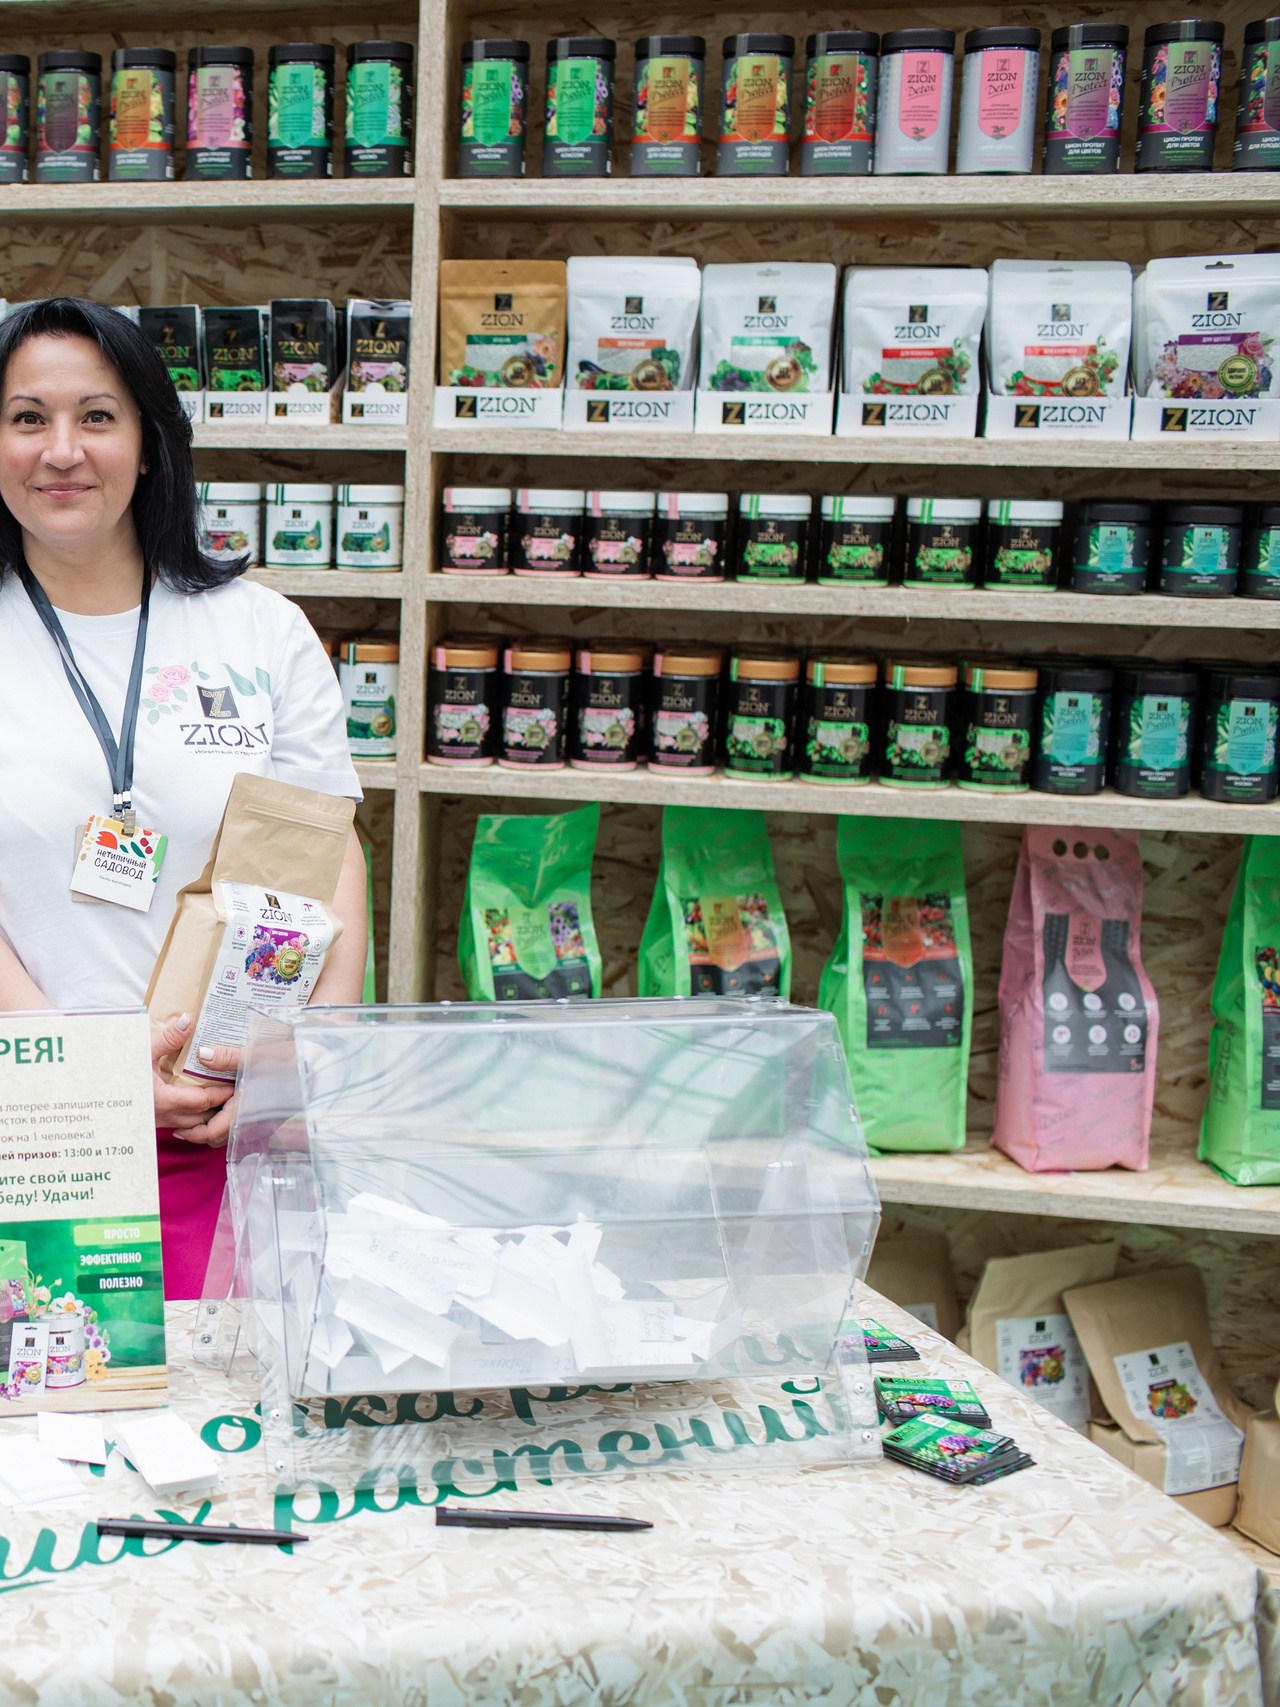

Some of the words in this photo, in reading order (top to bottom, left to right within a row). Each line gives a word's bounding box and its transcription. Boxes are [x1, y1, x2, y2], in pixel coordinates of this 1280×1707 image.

[1075, 72, 1106, 81] ZION
[1174, 65, 1205, 75] ZION
[907, 75, 937, 83] ZION
[987, 72, 1018, 82] ZION
[481, 313, 524, 327] ZION
[610, 316, 655, 330] ZION
[744, 315, 789, 329] ZION
[1191, 313, 1242, 328] ZION
[894, 325, 941, 338] ZION
[1037, 324, 1085, 337] ZION
[278, 342, 319, 355] ZION
[356, 339, 400, 354] ZION
[213, 348, 253, 361] ZION
[224, 403, 262, 414] ZION
[288, 403, 322, 414] ZION
[365, 404, 400, 414] ZION
[479, 397, 536, 415] ZION
[612, 402, 670, 418] ZION
[748, 403, 808, 420] ZION
[889, 403, 951, 421] ZION
[1041, 405, 1106, 423] ZION
[1190, 409, 1257, 426] ZION
[445, 690, 476, 701] ZION
[511, 694, 541, 705] ZION
[590, 694, 621, 704] ZION
[201, 689, 231, 717] Z
[662, 697, 693, 708] ZION
[738, 701, 770, 713] ZION
[824, 707, 856, 719] ZION
[904, 709, 938, 722] ZION
[984, 712, 1017, 724] ZION
[1235, 717, 1262, 726] ZION
[179, 723, 270, 748] ZION
[94, 858, 144, 880] САДОВОД
[260, 908, 293, 923] ZION
[5, 1103, 50, 1114] лотерее
[52, 1100, 104, 1110] запишите
[106, 1099, 132, 1108] свои
[30, 1116, 37, 1124] в
[39, 1114, 93, 1125] лототрон.
[16, 1134, 30, 1142] на
[41, 1129, 95, 1141] человека!
[17, 1150, 61, 1162] призов:
[64, 1148, 93, 1158] 13:00
[106, 1145, 134, 1156] 17:00
[29, 1170, 67, 1186] свой
[71, 1170, 112, 1183] шанс
[42, 1187, 94, 1204] Удачи!
[103, 1227, 141, 1240] ПРОСТО
[80, 1252, 142, 1266] ЭФФЕКТИВНО
[99, 1276, 143, 1289] ПОЛЕЗНО
[16, 1348, 42, 1356] ZION
[50, 1345, 71, 1353] ZION
